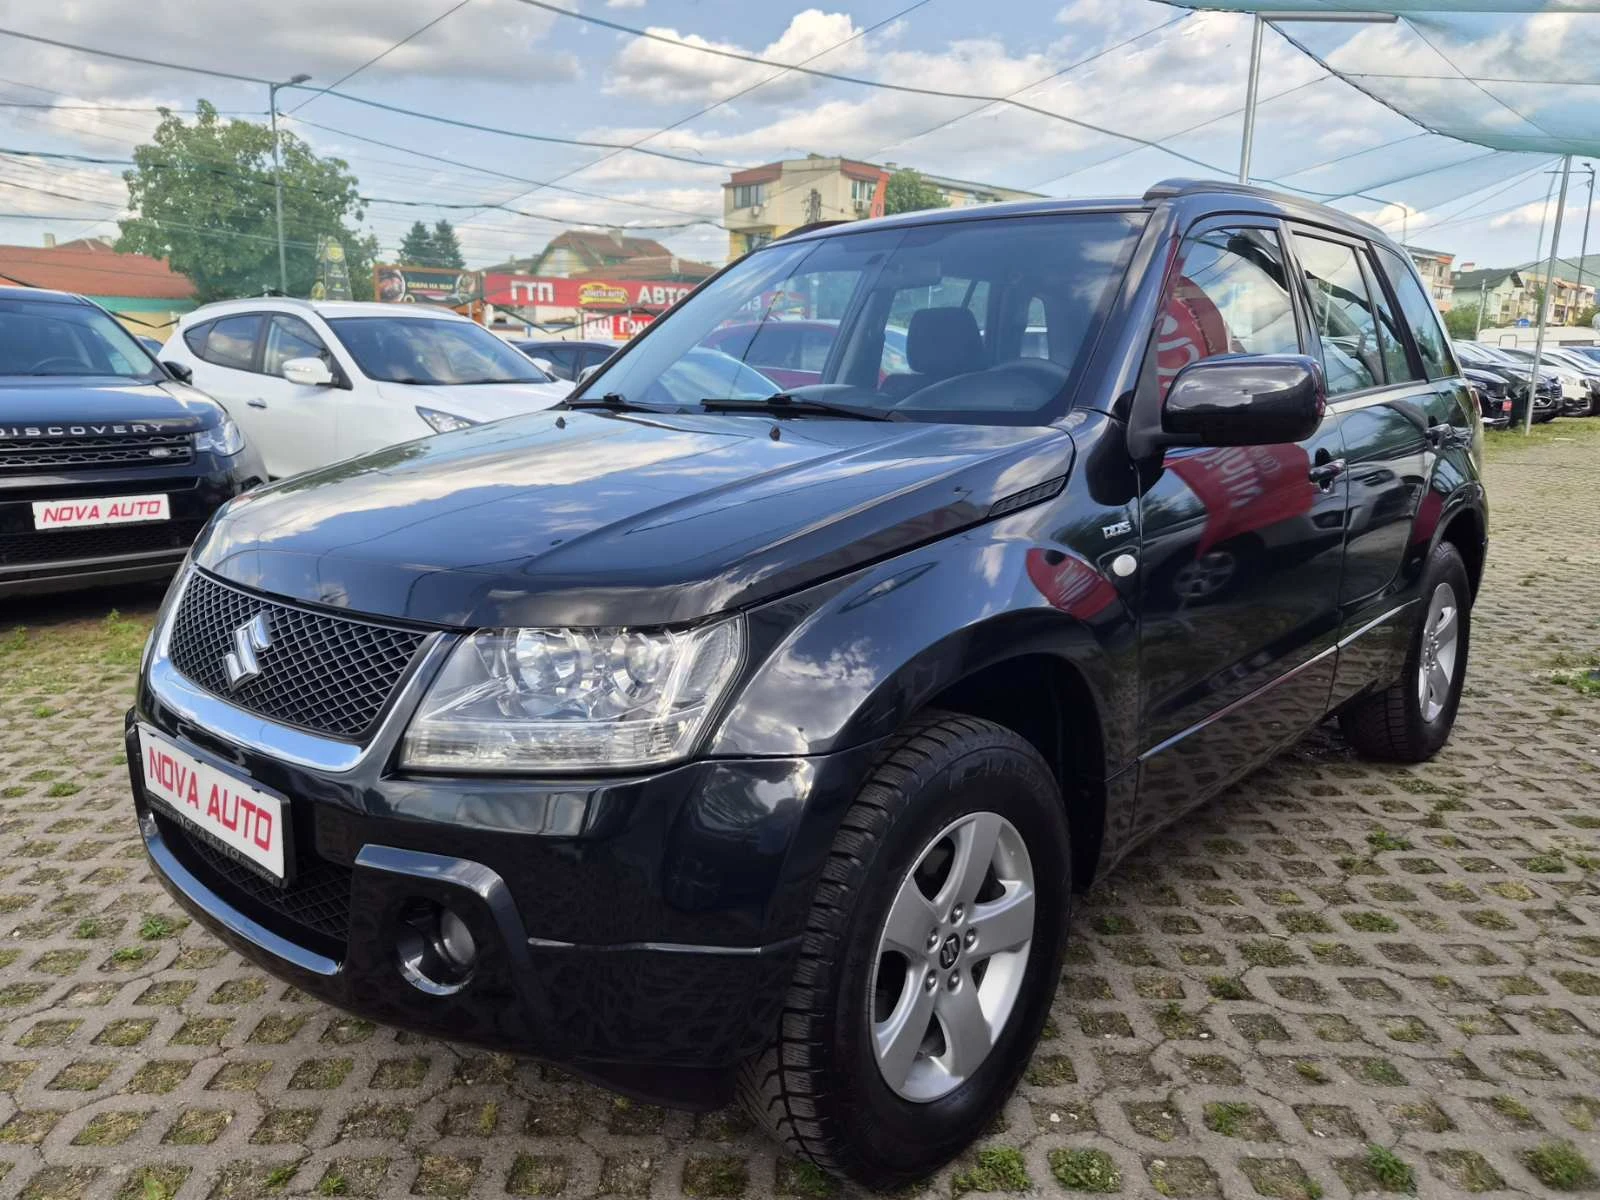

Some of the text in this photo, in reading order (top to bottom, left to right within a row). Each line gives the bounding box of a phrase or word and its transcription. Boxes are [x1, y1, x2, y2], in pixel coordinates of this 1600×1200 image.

[511, 280, 554, 302] ГТП
[43, 501, 161, 523] NOVA AUTO
[149, 746, 273, 851] NOVA AUTO
